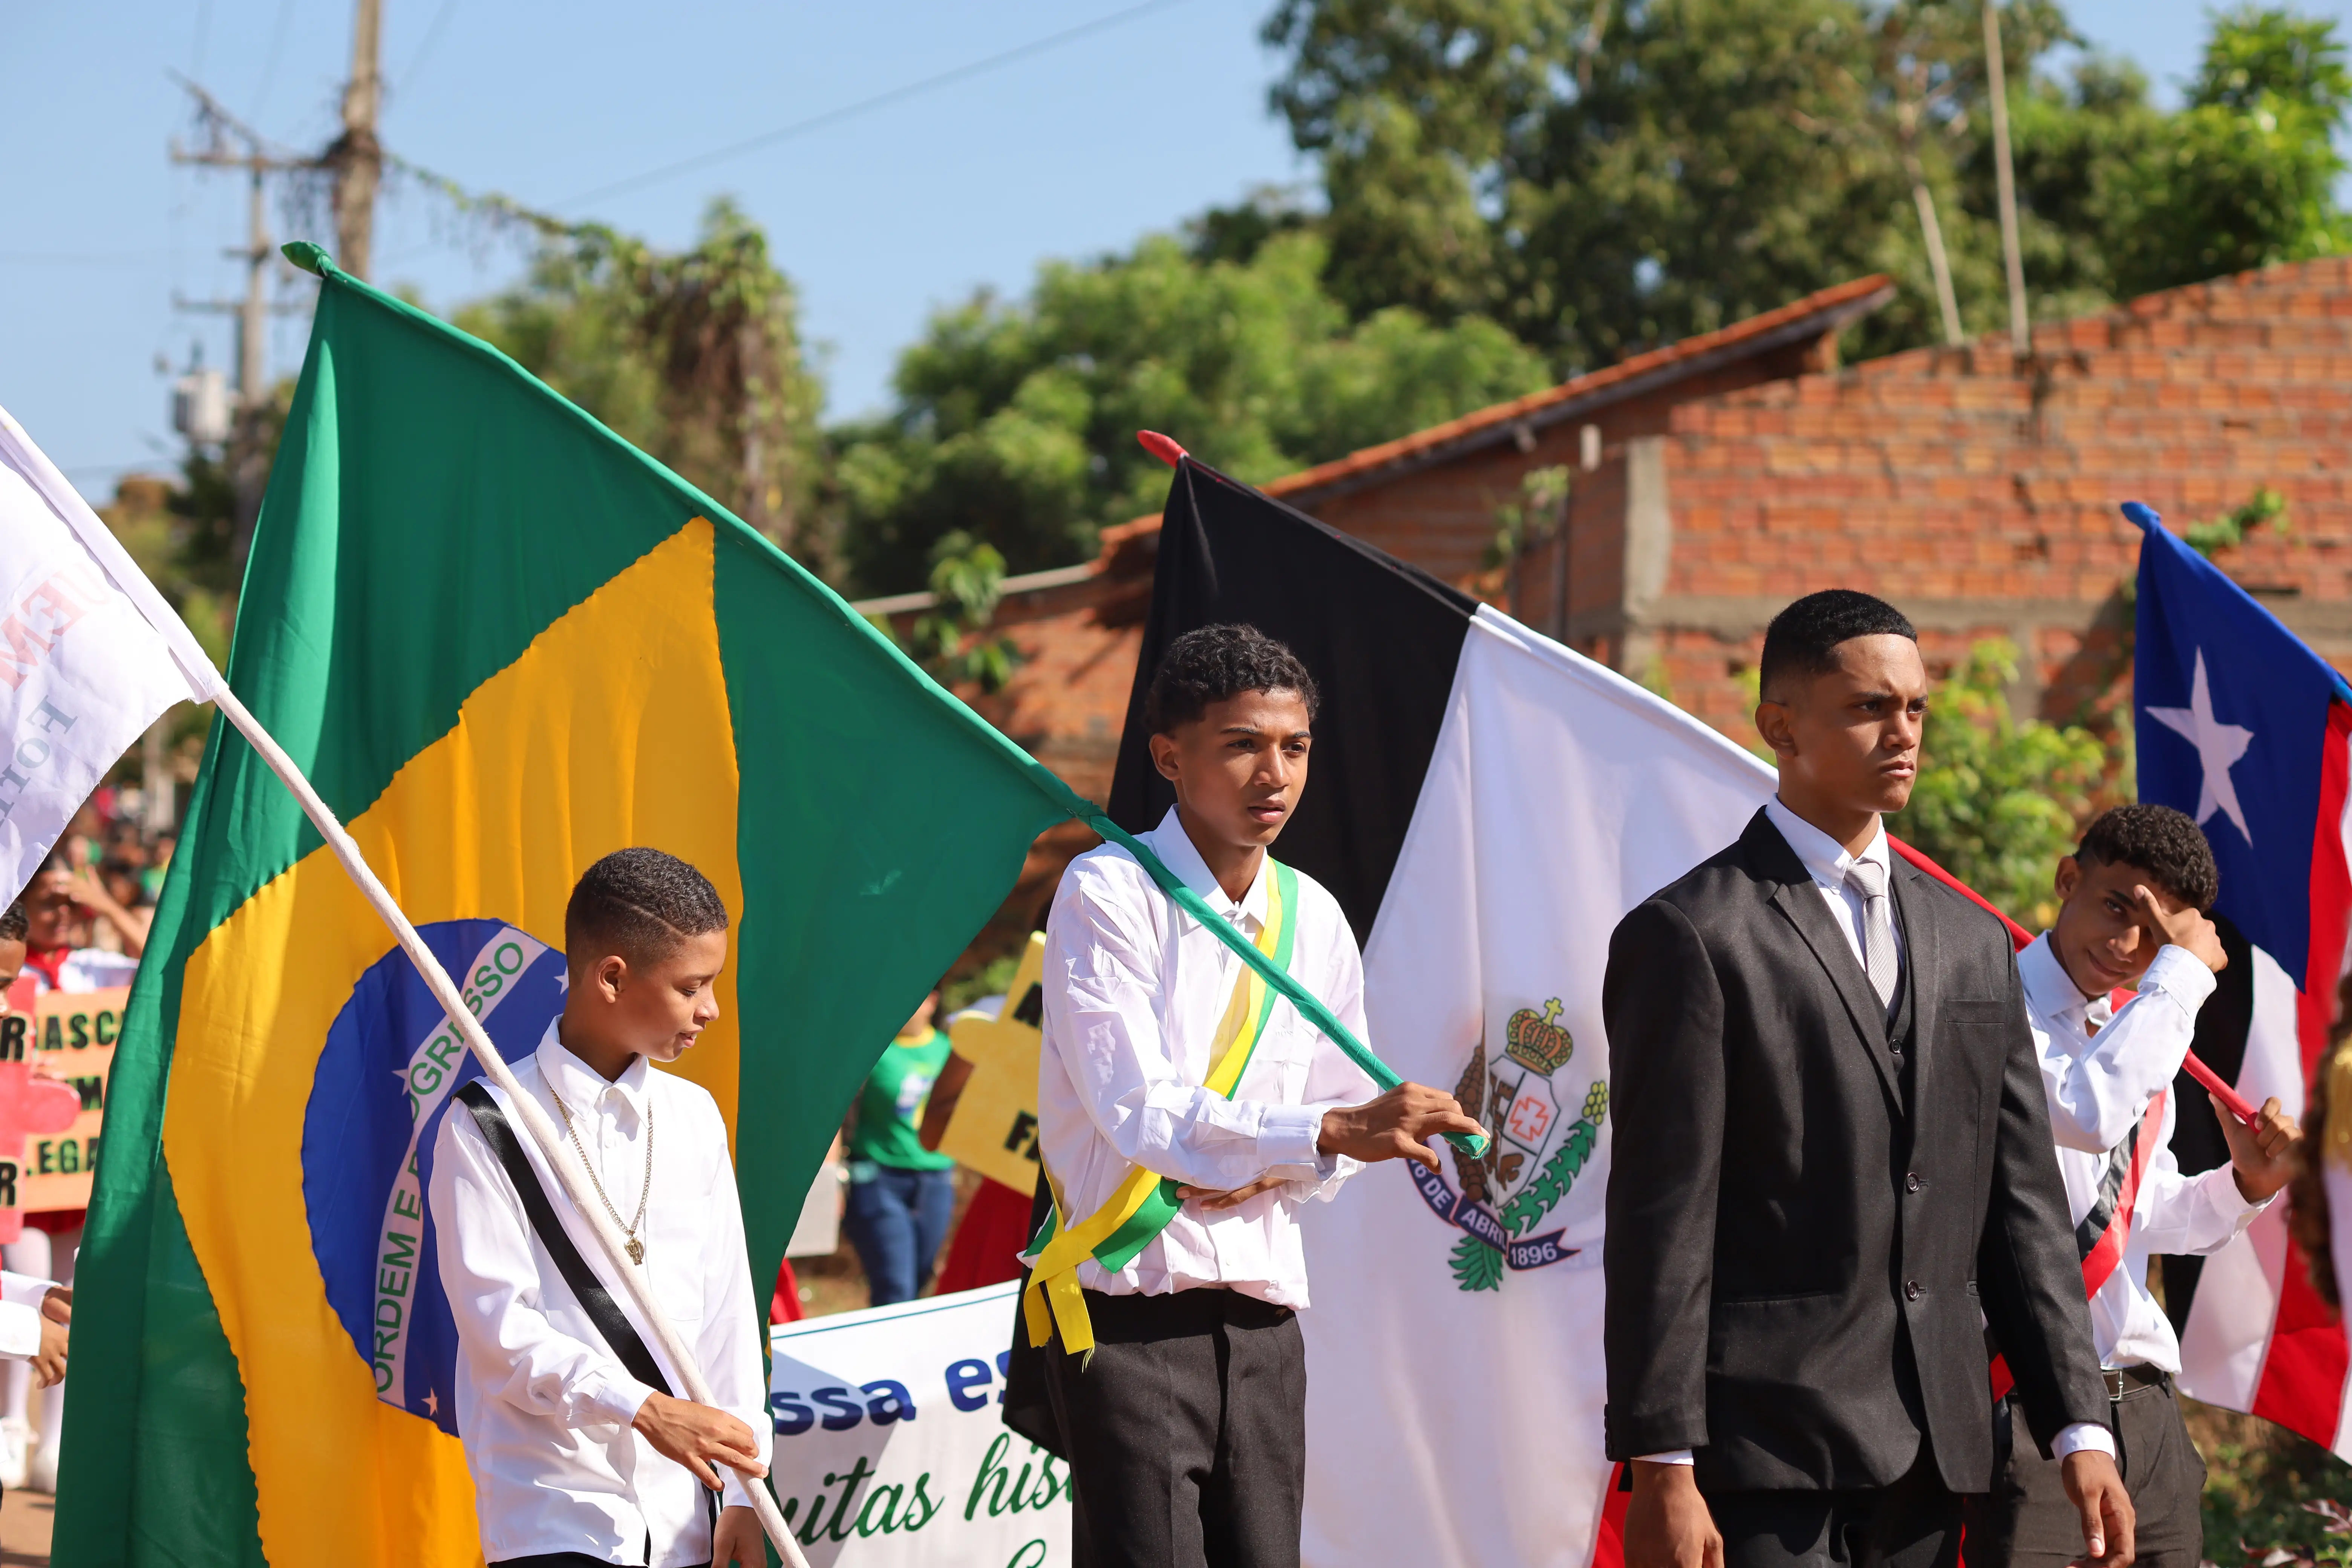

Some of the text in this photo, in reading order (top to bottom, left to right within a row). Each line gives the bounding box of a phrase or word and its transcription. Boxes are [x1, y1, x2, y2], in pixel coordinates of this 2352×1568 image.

[35, 1010, 125, 1050] ASC
[394, 1189, 421, 1221] E
[1422, 1176, 1452, 1210] DE
[1510, 1242, 1557, 1266] 1896
[375, 1231, 416, 1393] ORDEM
